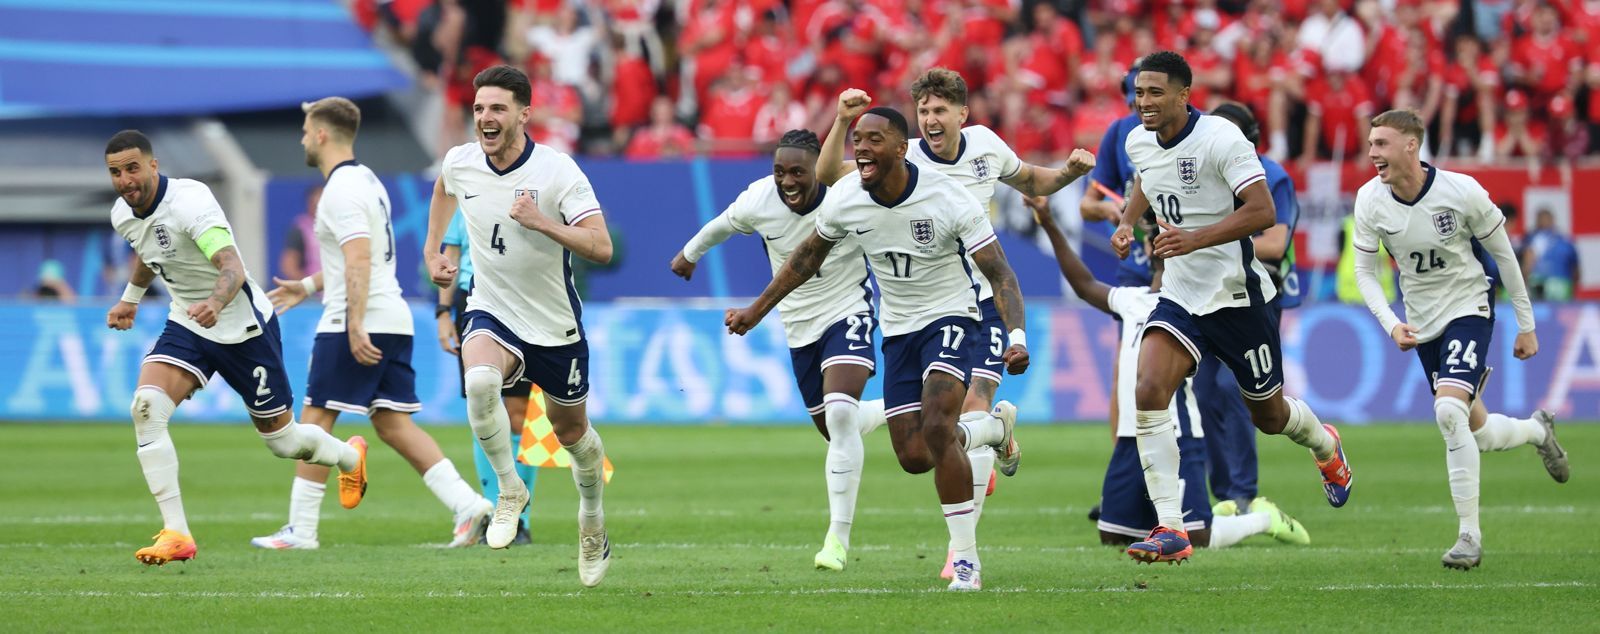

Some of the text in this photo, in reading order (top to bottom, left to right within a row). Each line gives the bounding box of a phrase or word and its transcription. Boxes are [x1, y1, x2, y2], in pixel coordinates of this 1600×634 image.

[1156, 193, 1184, 225] 10
[491, 223, 507, 255] 4
[884, 251, 911, 278] 17
[1409, 249, 1447, 274] 24
[845, 315, 873, 344] 21
[940, 324, 965, 351] 17
[989, 326, 1003, 357] 5
[1244, 343, 1272, 379] 10
[1446, 339, 1478, 370] 24
[252, 365, 272, 397] 2
[567, 357, 581, 387] 4
